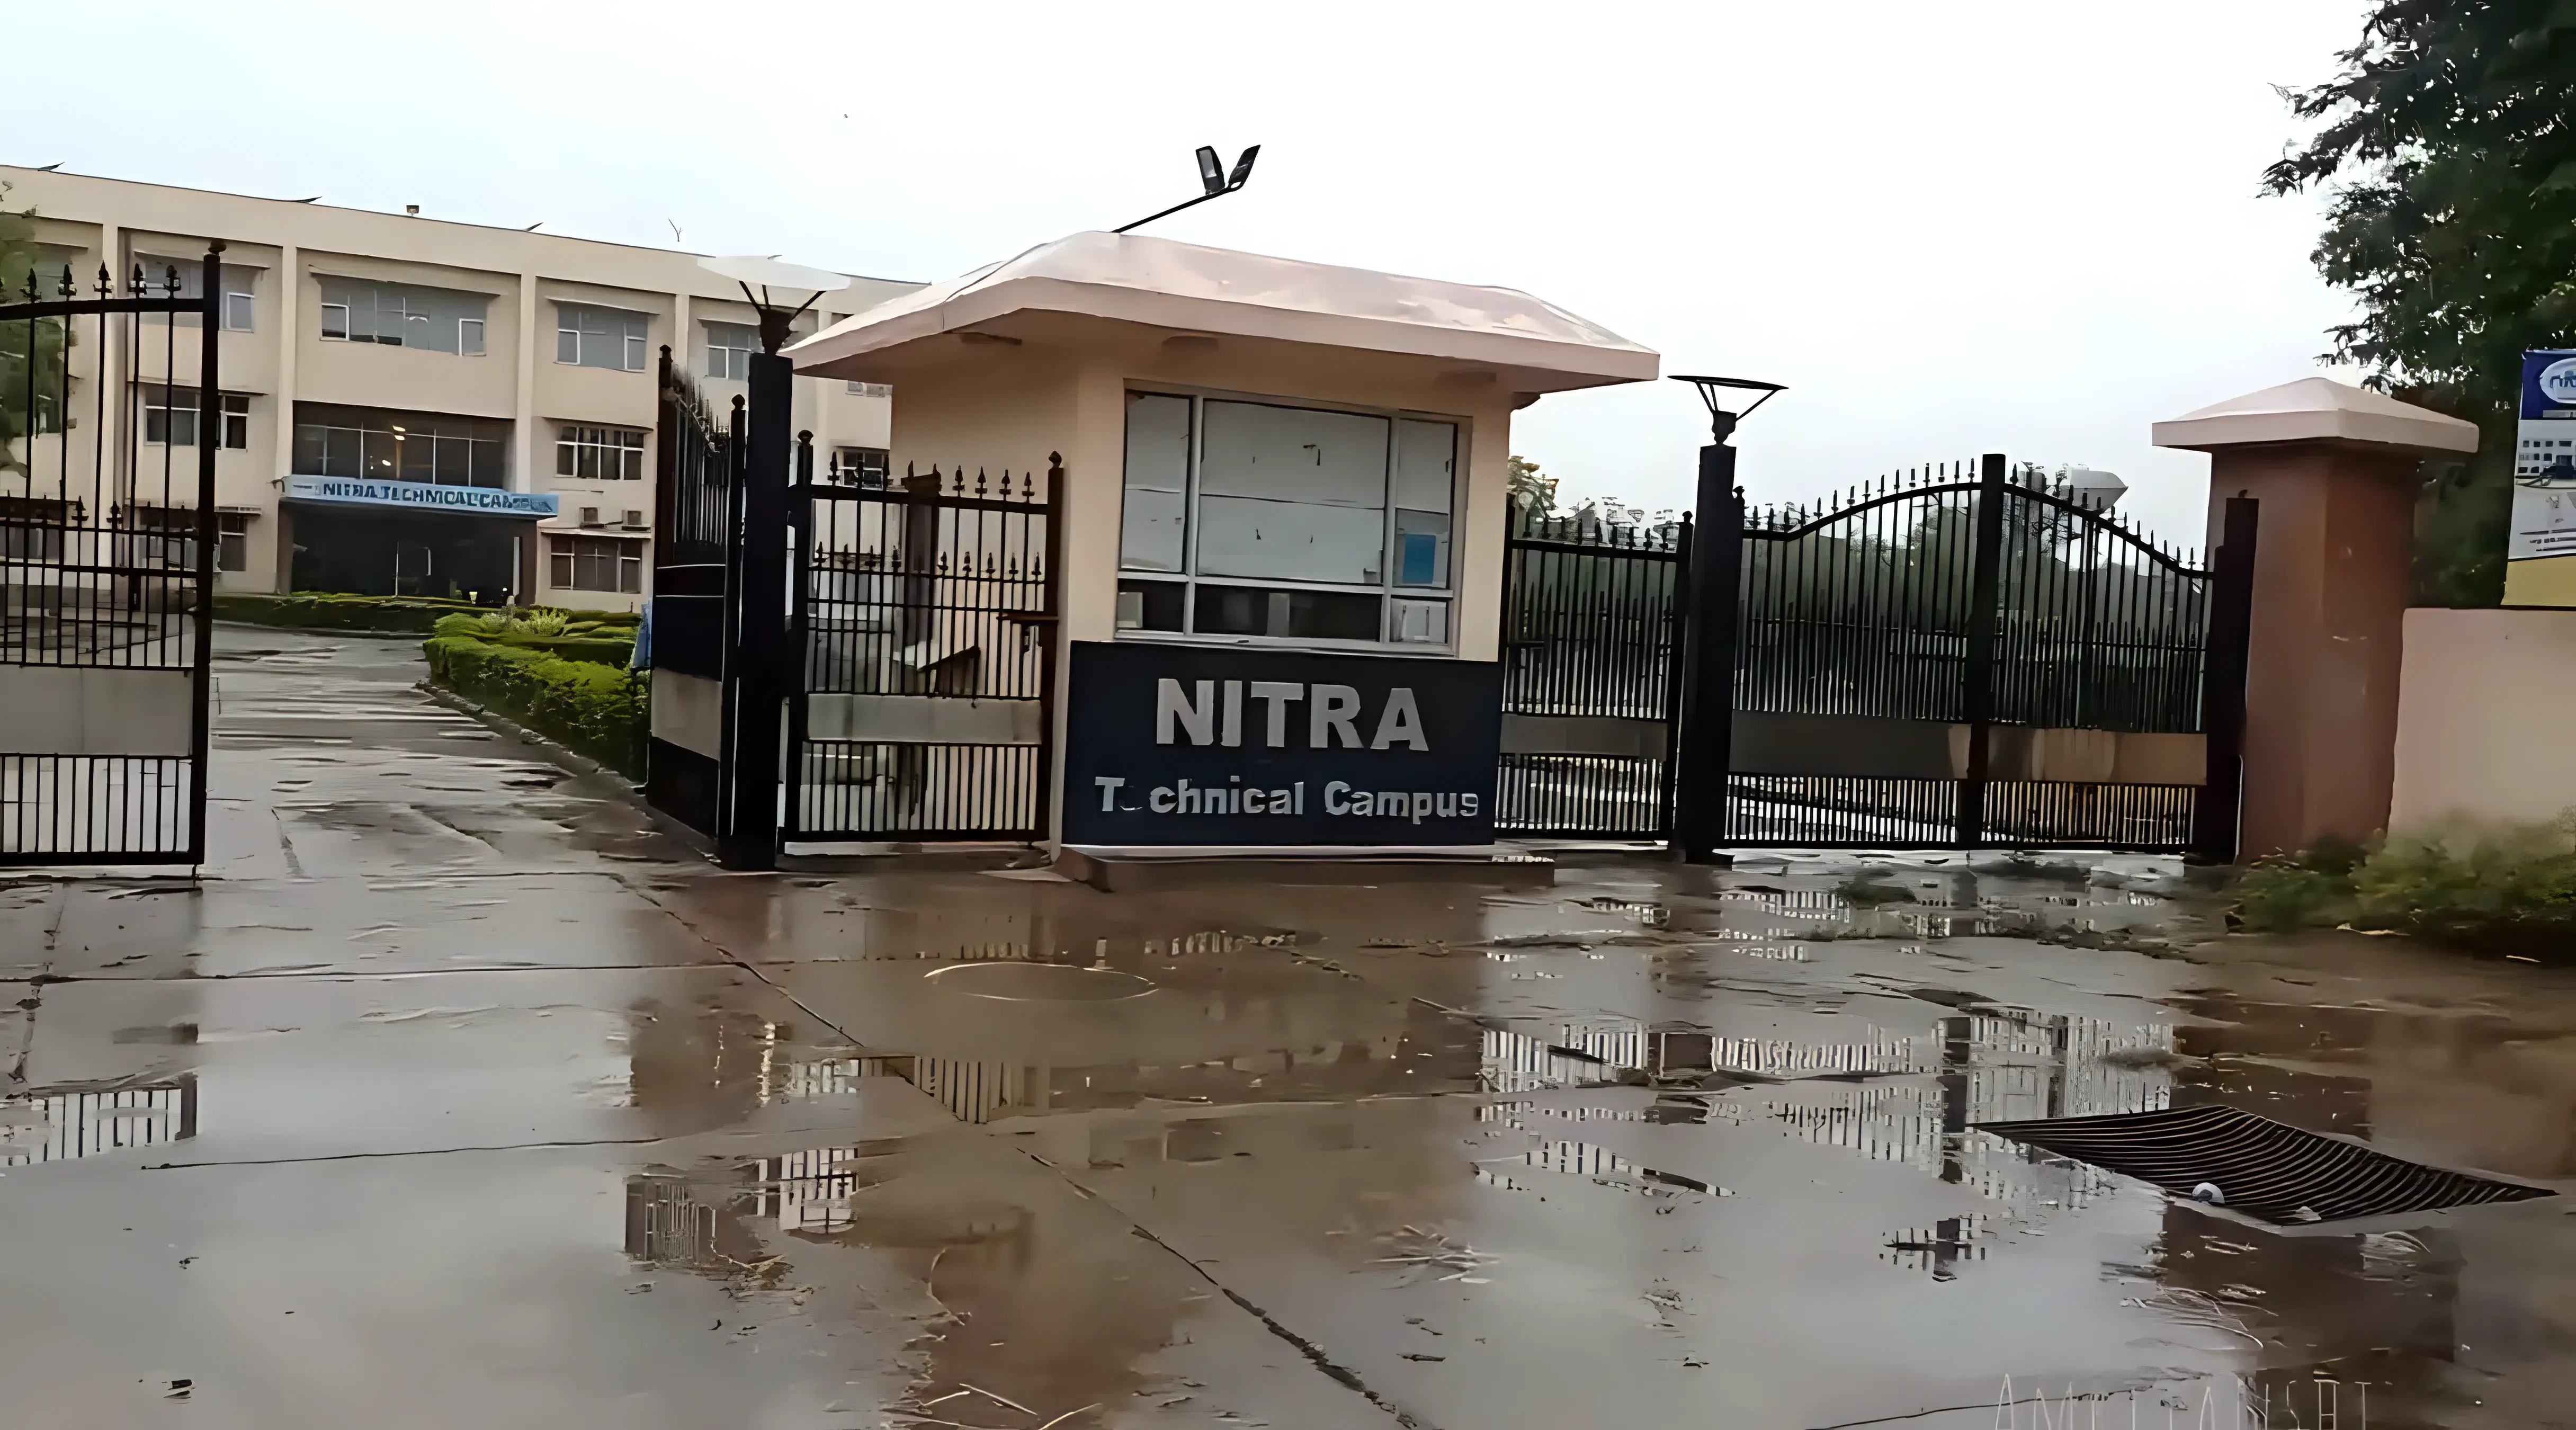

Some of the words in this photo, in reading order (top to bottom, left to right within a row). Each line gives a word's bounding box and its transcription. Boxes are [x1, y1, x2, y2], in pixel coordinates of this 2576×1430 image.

[1156, 678, 1429, 751] NITRA
[1095, 775, 1304, 815] Tchnical
[1324, 781, 1479, 825] Campus
